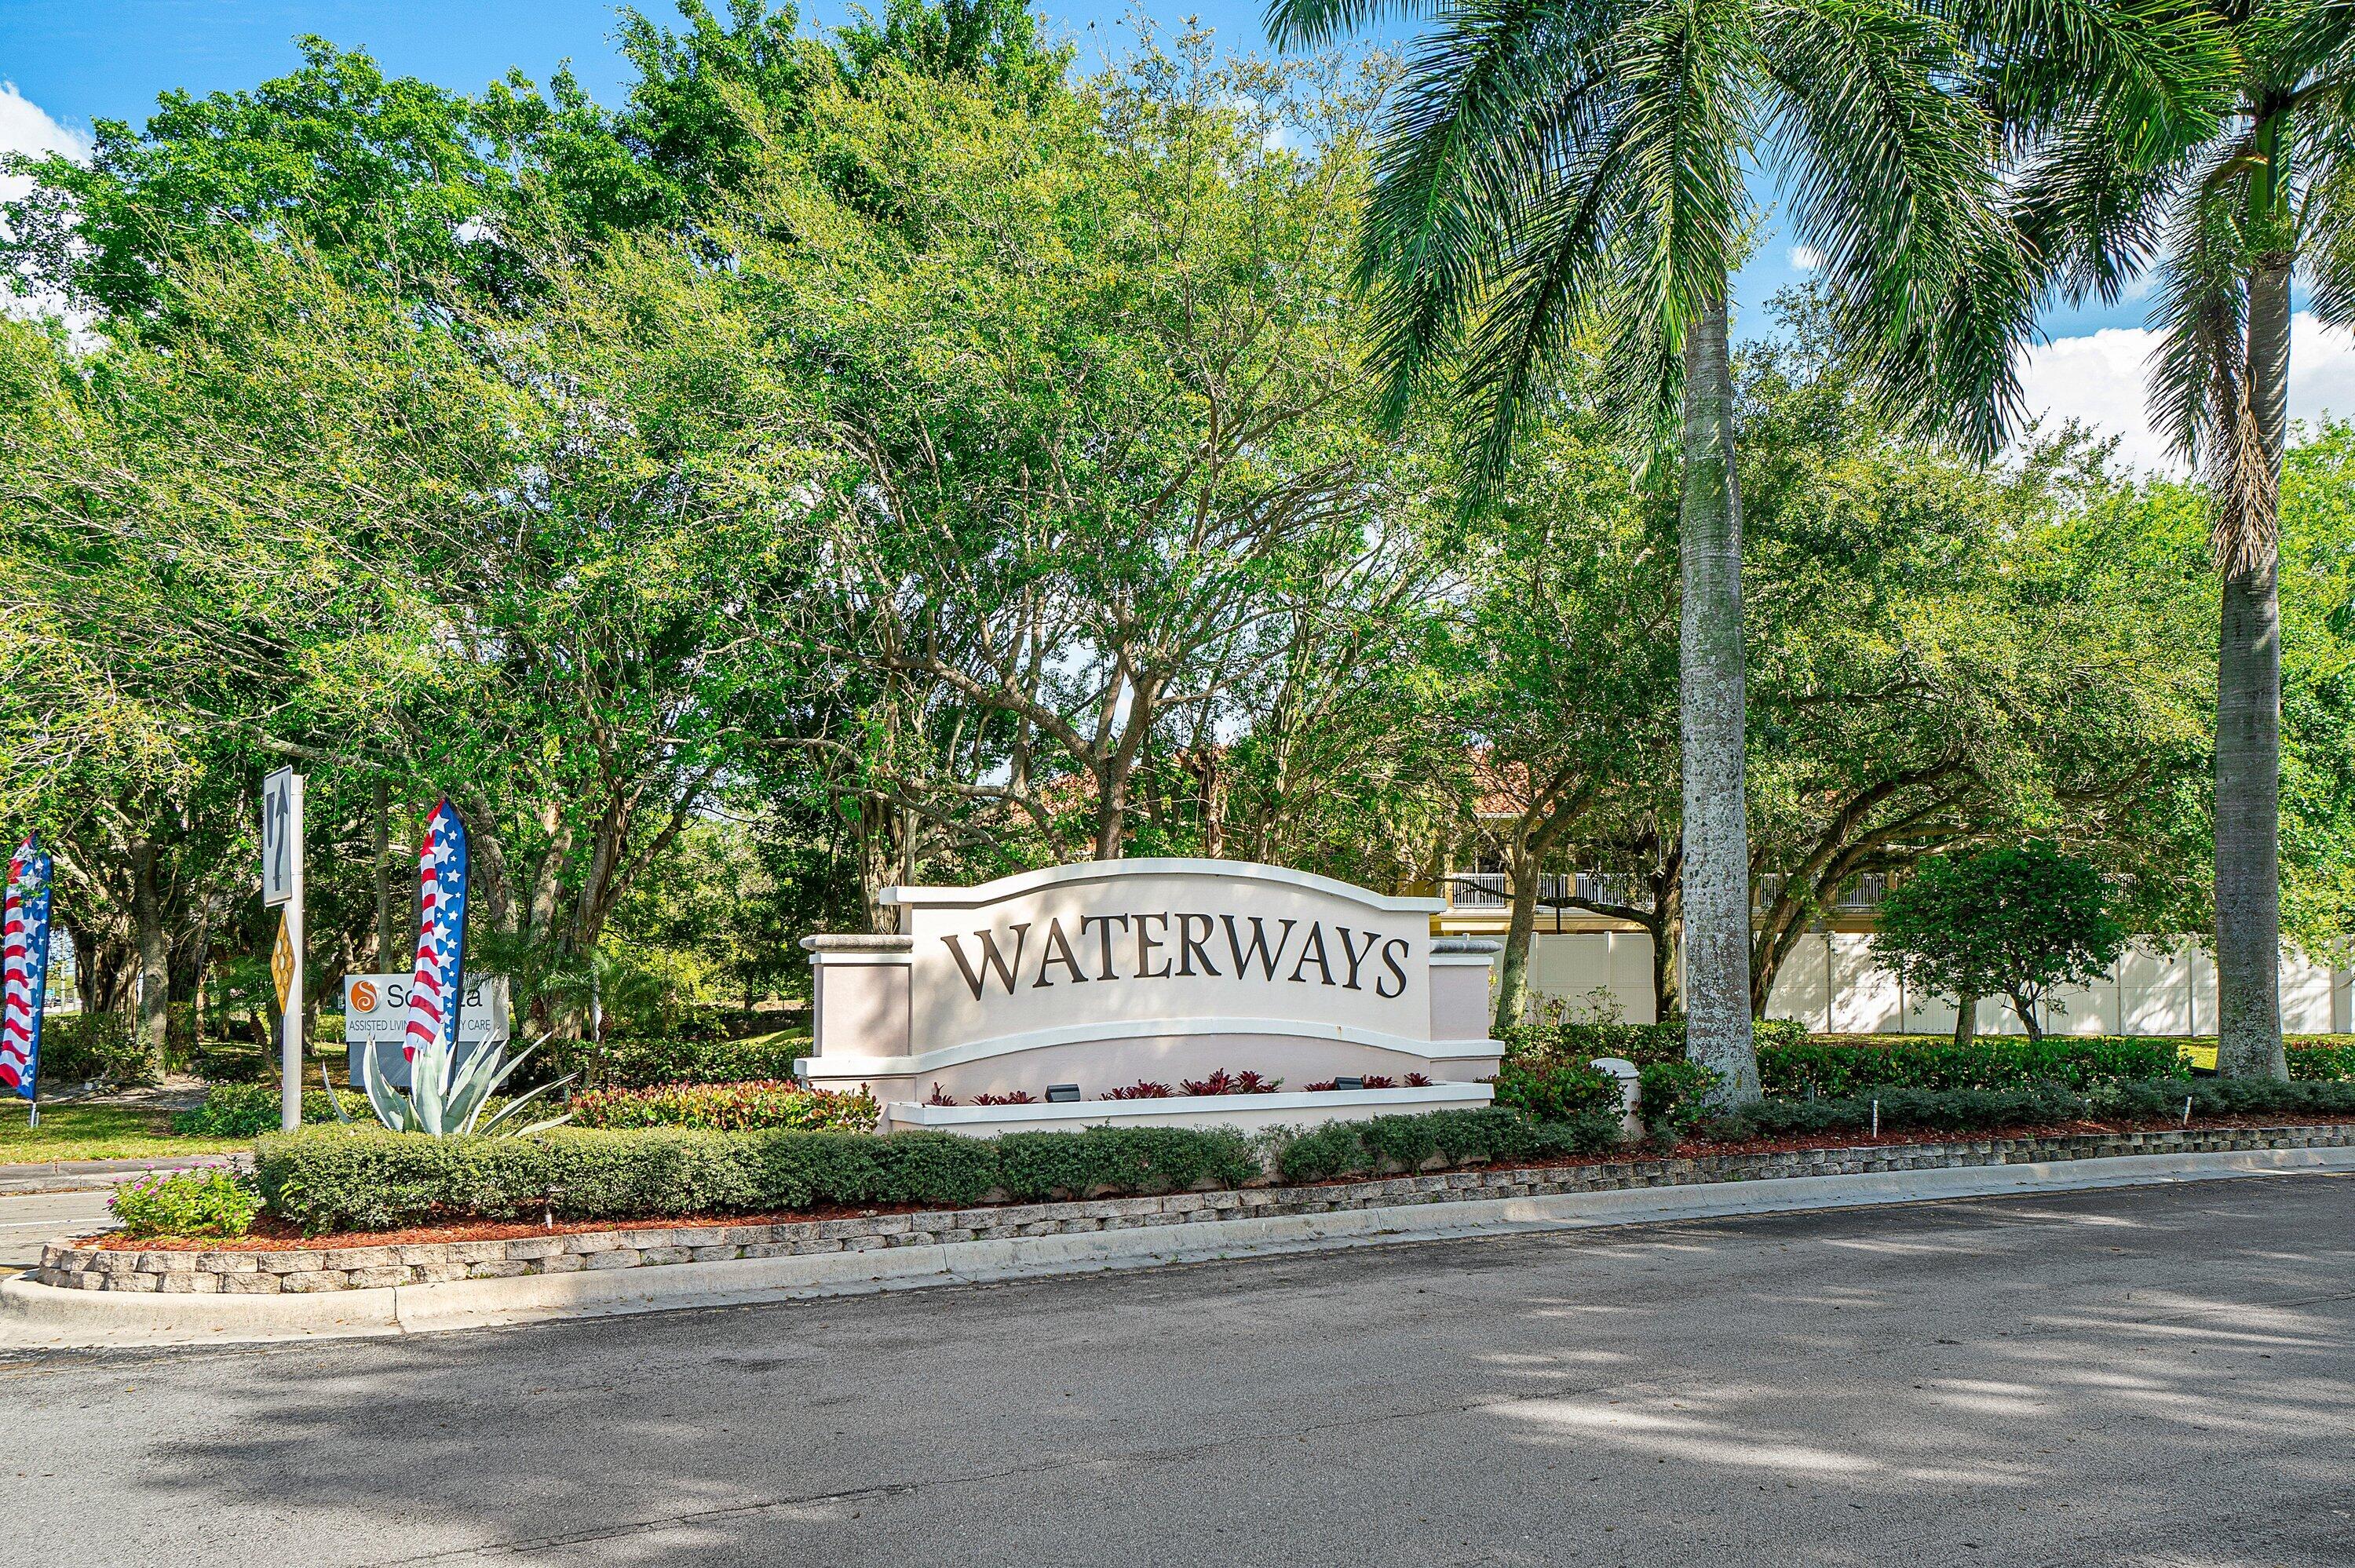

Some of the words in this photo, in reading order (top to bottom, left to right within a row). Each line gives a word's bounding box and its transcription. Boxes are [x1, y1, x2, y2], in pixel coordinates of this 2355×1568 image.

[940, 910, 1410, 1002] WATERWAYS
[349, 1019, 388, 1031] ASSISTED
[467, 1019, 491, 1030] CARE
